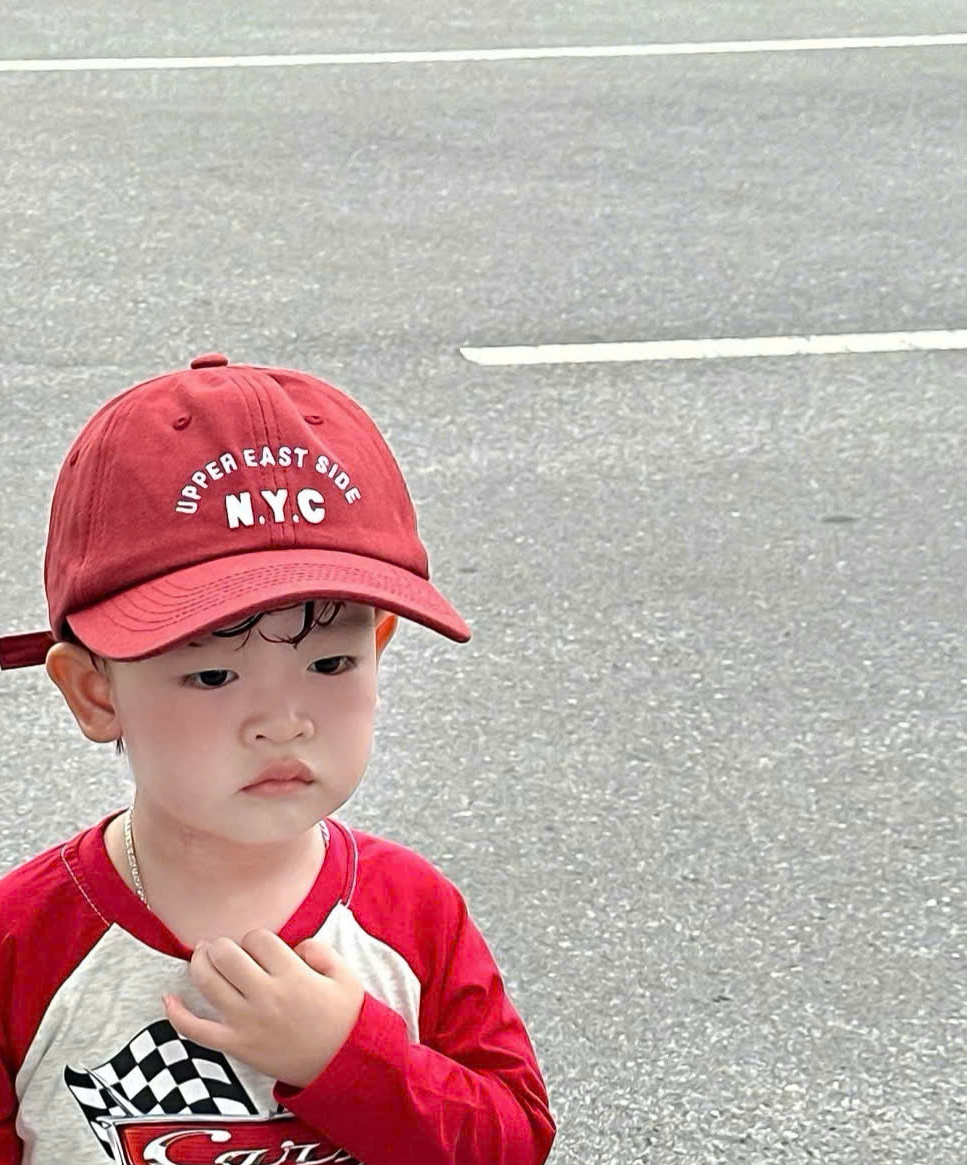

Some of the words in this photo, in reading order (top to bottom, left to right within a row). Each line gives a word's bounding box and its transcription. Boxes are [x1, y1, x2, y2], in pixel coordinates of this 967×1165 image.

[174, 452, 239, 516] UPPER
[243, 445, 310, 469] EAST
[314, 454, 363, 505] SIDE
[224, 487, 327, 530] N.Y.C
